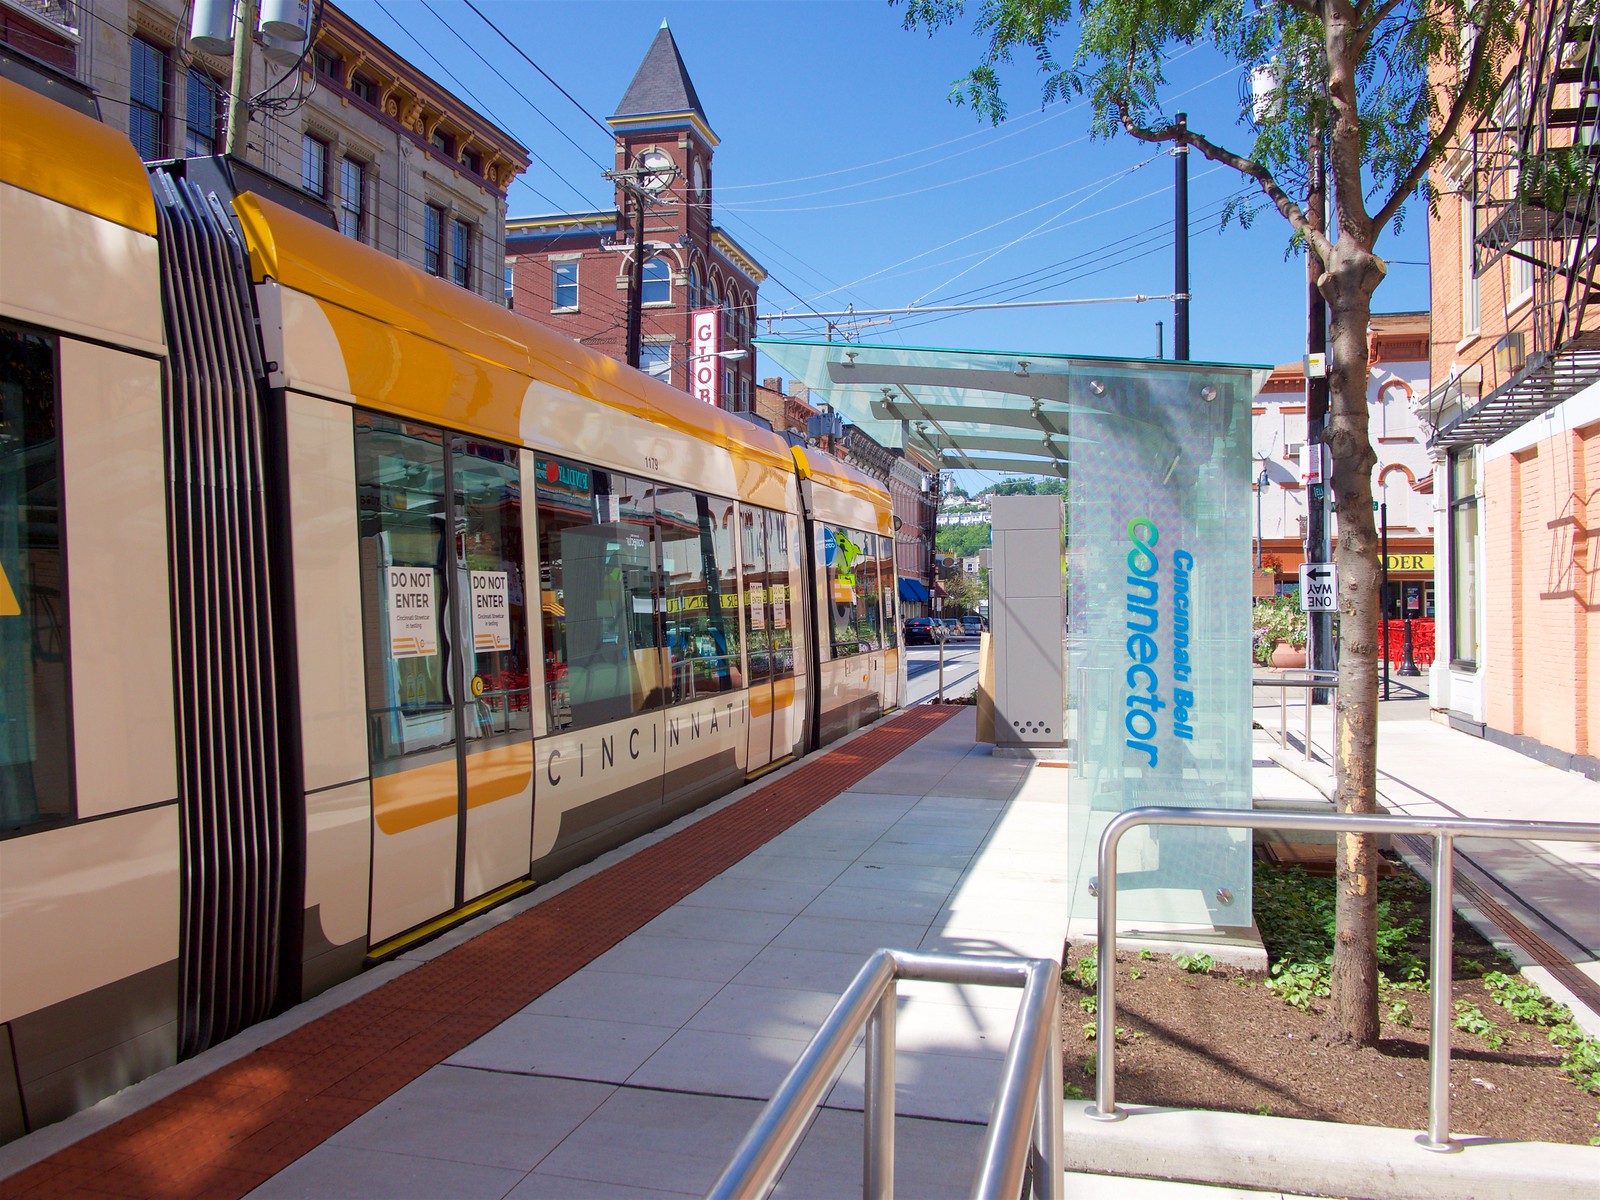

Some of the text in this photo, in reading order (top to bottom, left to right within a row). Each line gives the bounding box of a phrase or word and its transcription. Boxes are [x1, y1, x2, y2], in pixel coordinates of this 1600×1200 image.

[645, 456, 659, 471] 1179
[391, 572, 431, 588] DO NOT
[473, 576, 505, 590] DO NOT
[1307, 584, 1332, 594] WAY
[395, 593, 429, 608] ENTER
[477, 594, 504, 608] ENTER
[1308, 597, 1332, 607] ONE
[1173, 550, 1195, 740] Cincinnati Bell
[547, 700, 745, 786] CINCINNATI
